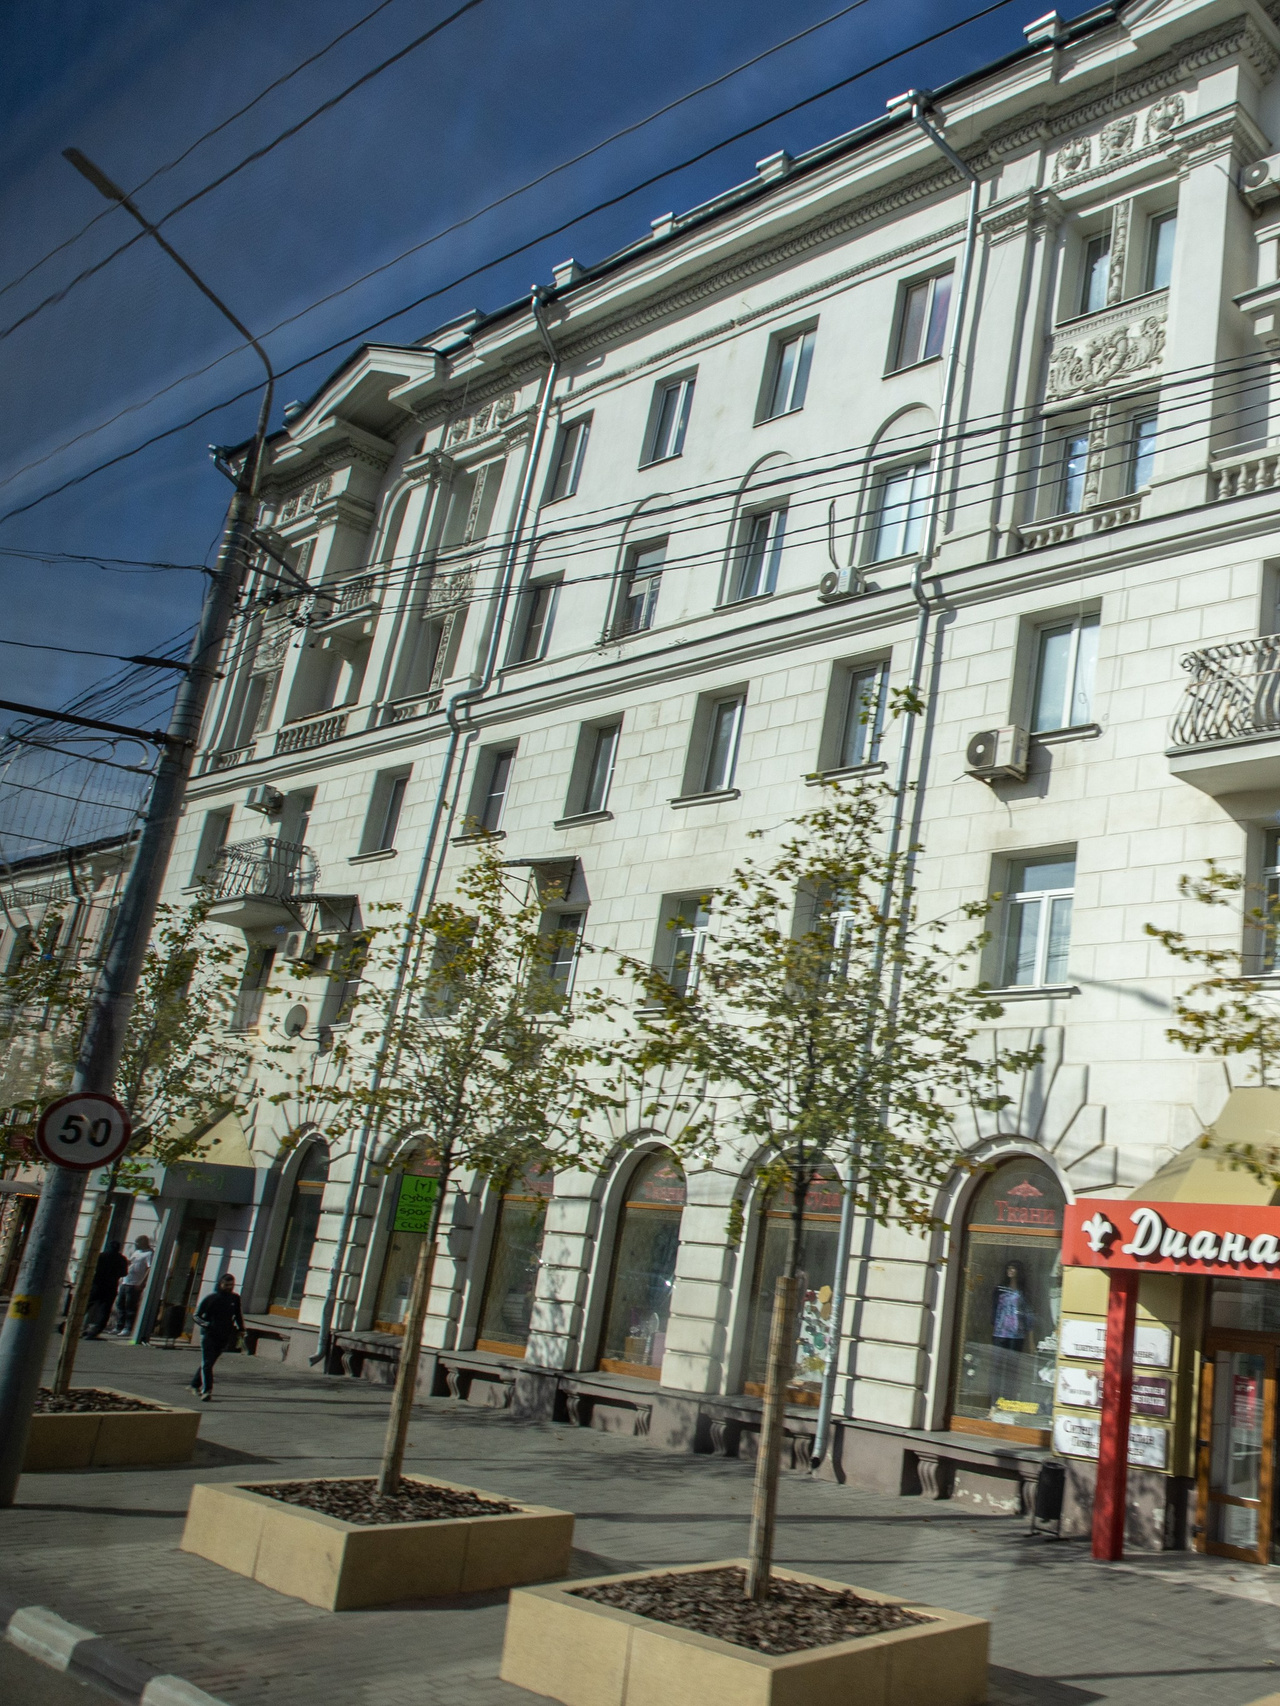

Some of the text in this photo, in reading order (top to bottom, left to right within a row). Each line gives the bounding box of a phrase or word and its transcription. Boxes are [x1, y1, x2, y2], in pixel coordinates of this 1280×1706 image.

[59, 1114, 112, 1148] 50
[994, 1200, 1056, 1225] Ткани
[1121, 1207, 1280, 1264] Диана
